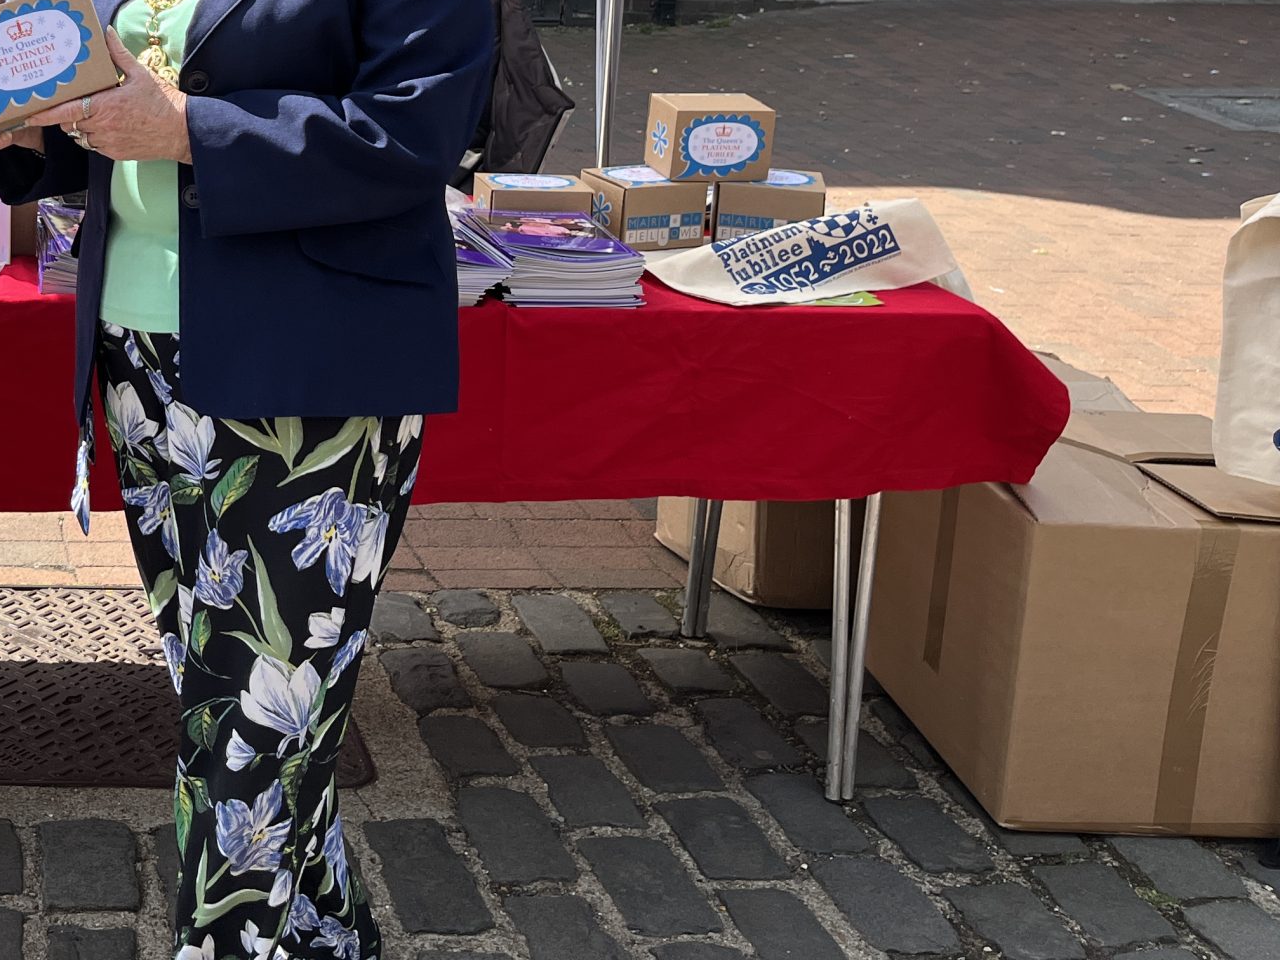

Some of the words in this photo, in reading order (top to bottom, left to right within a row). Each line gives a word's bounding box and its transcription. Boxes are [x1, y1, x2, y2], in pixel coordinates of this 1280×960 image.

[15, 31, 57, 52] Queen's
[10, 55, 53, 78] JUBILEE
[22, 69, 45, 82] 2022
[628, 216, 670, 230] MARY
[628, 225, 700, 241] FELLOWS
[720, 215, 770, 230] MARY
[717, 223, 804, 269] Platinum
[726, 242, 804, 286] Jubilee
[769, 260, 820, 293] 1952
[839, 229, 895, 265] 2022
